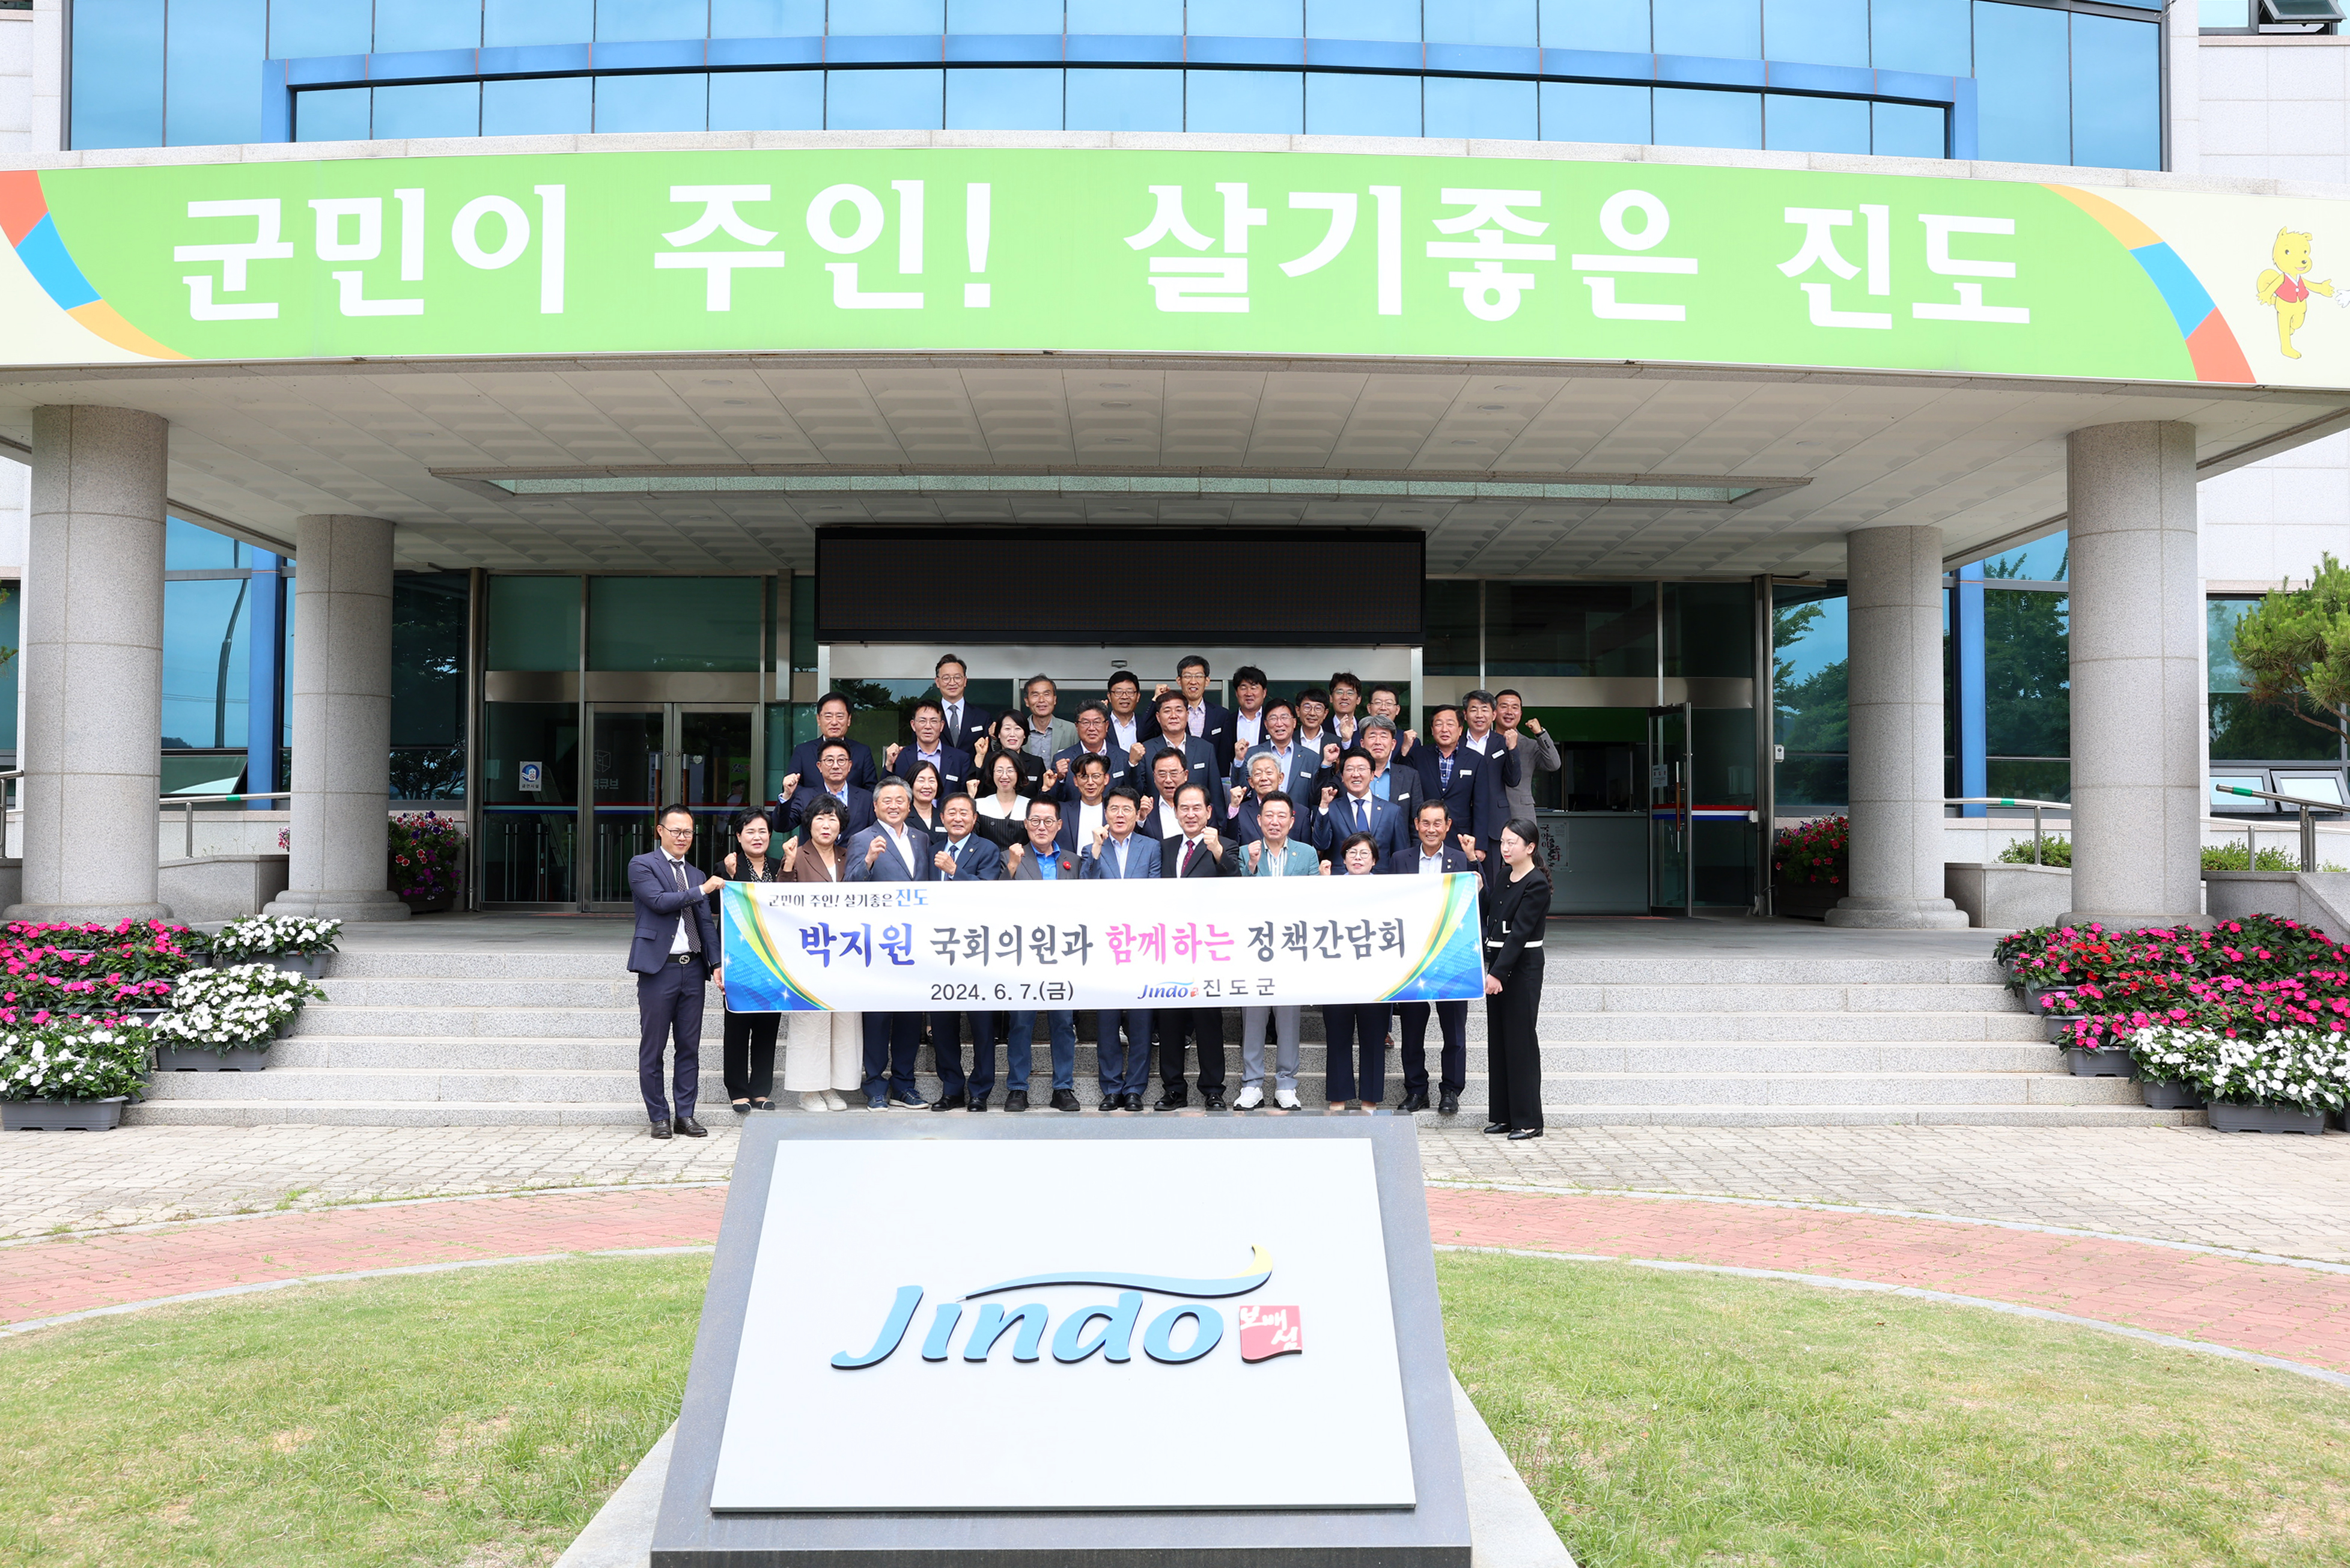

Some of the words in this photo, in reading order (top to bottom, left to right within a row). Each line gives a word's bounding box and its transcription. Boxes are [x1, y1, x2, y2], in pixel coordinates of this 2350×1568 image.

[174, 184, 565, 321] 군민이
[654, 180, 991, 312] 주인!
[1123, 182, 1699, 322] 살기좋은
[1776, 204, 2030, 330] 진도
[769, 895, 804, 907] 군민이
[810, 895, 839, 908] 주인!
[799, 922, 915, 968] 박지원
[930, 924, 1094, 967] 국회의원과
[1106, 922, 1235, 965] 함께하는
[1247, 918, 1405, 962] 정책간담회
[931, 983, 986, 1001] 2024.
[994, 983, 1012, 1001] 6.
[1020, 980, 1074, 1001] 7.(금)
[1137, 985, 1189, 999] Jindo
[831, 1285, 1224, 1370] Jindo
